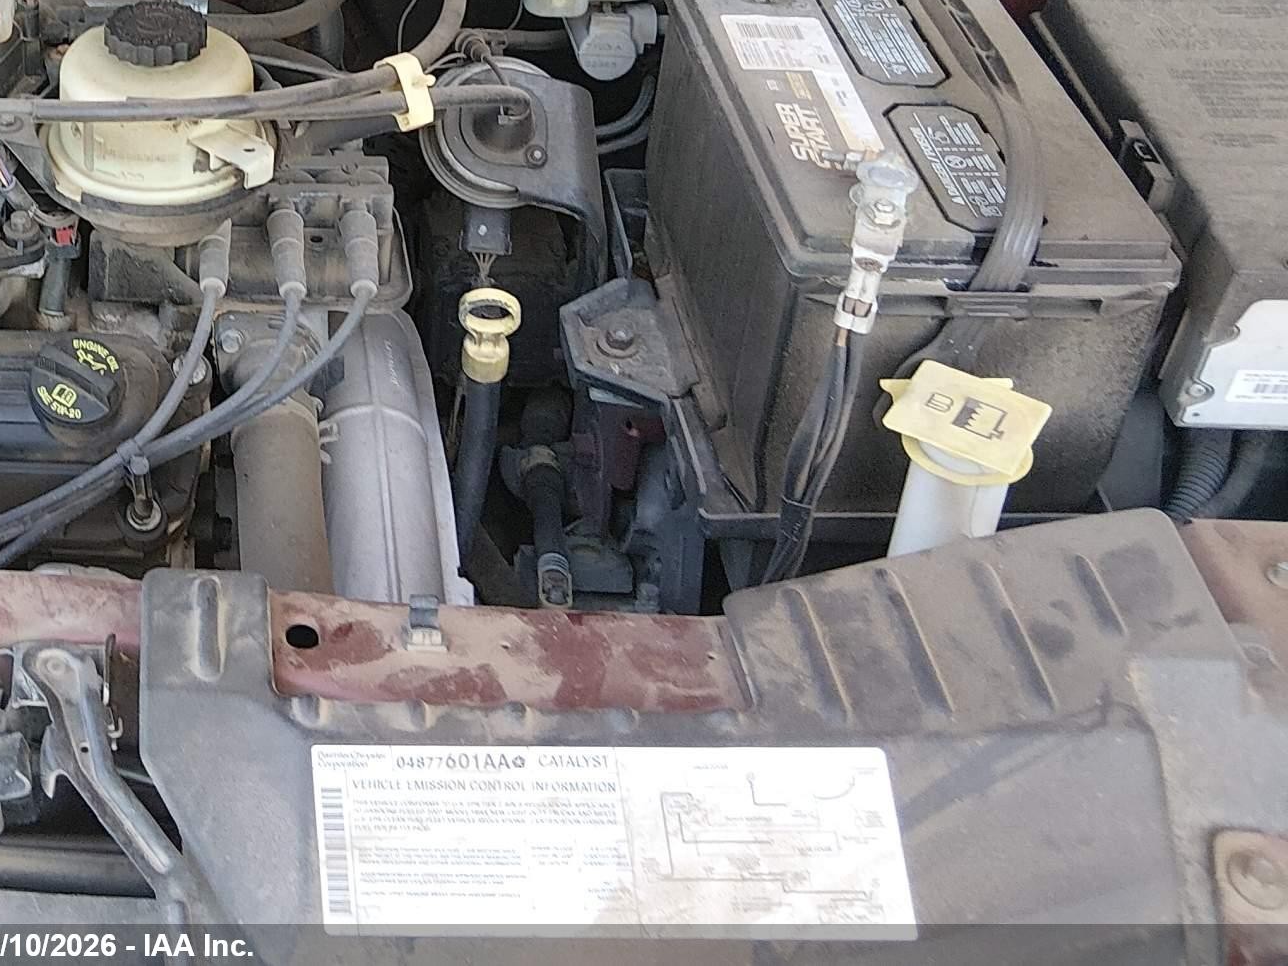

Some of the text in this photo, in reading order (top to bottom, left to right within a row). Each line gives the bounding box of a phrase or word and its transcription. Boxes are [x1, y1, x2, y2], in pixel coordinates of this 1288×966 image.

[775, 102, 810, 161] SUPER
[792, 102, 833, 169] START
[73, 338, 120, 374] ENGINE OIL
[396, 752, 609, 770] 04877601AA CATALYST
[352, 779, 617, 793] VEHICLE EMISSION CONTROL INFORMATION
